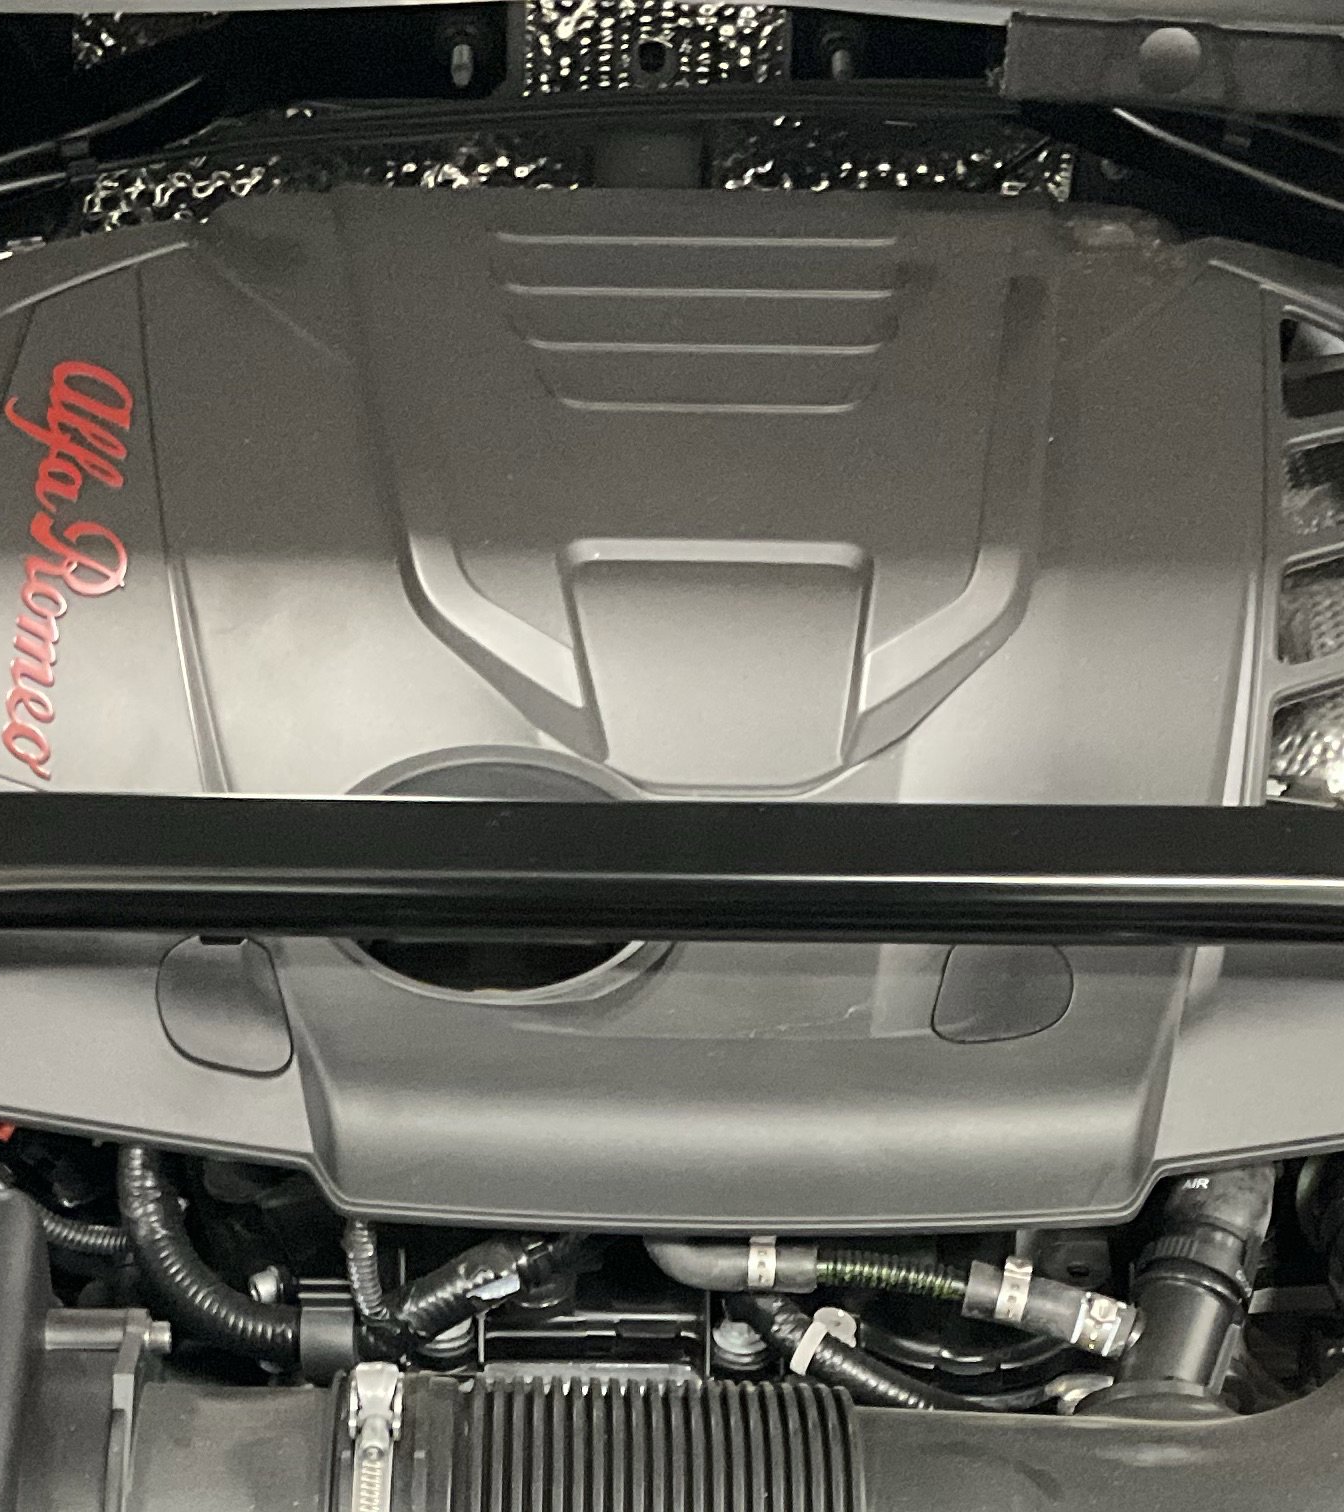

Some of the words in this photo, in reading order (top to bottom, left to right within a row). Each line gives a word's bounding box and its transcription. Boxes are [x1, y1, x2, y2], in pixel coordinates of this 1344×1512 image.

[4, 360, 134, 511] Alfa
[1, 511, 129, 781] Romeo
[1182, 1178, 1210, 1190] AIR
